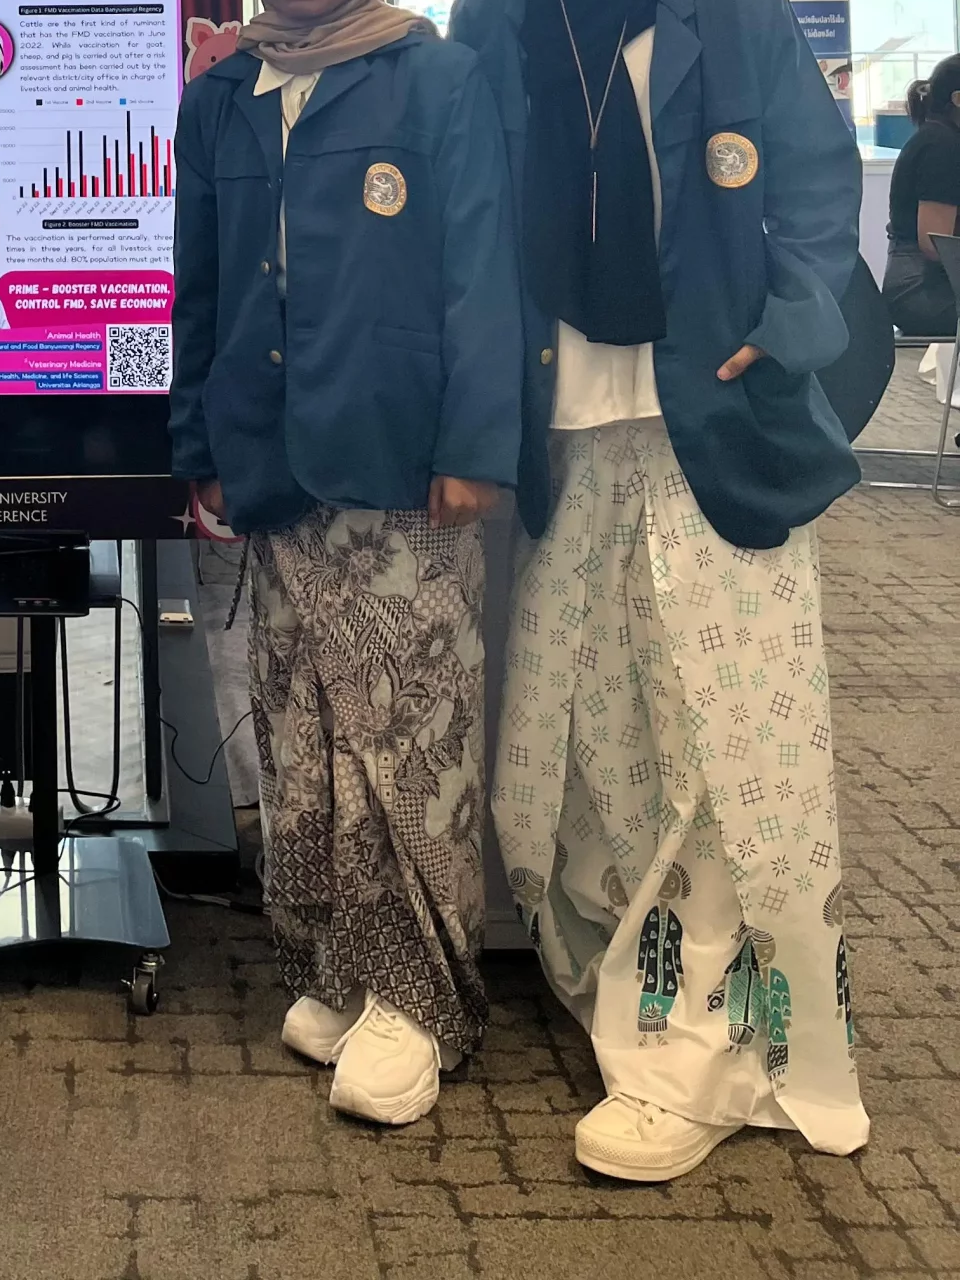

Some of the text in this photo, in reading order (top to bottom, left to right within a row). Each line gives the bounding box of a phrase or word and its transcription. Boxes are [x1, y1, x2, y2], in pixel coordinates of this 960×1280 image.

[77, 234, 115, 242] performed
[70, 255, 89, 263] 80%
[90, 256, 128, 264] population
[9, 284, 39, 295] PRIME
[52, 283, 97, 295] BOOSTER
[100, 283, 171, 294] VACCINATION,
[15, 299, 60, 310] CONTROL
[90, 298, 117, 309] SAVE
[120, 298, 167, 309] ECONOMY
[75, 331, 101, 339] Health
[69, 360, 102, 369] Medicine
